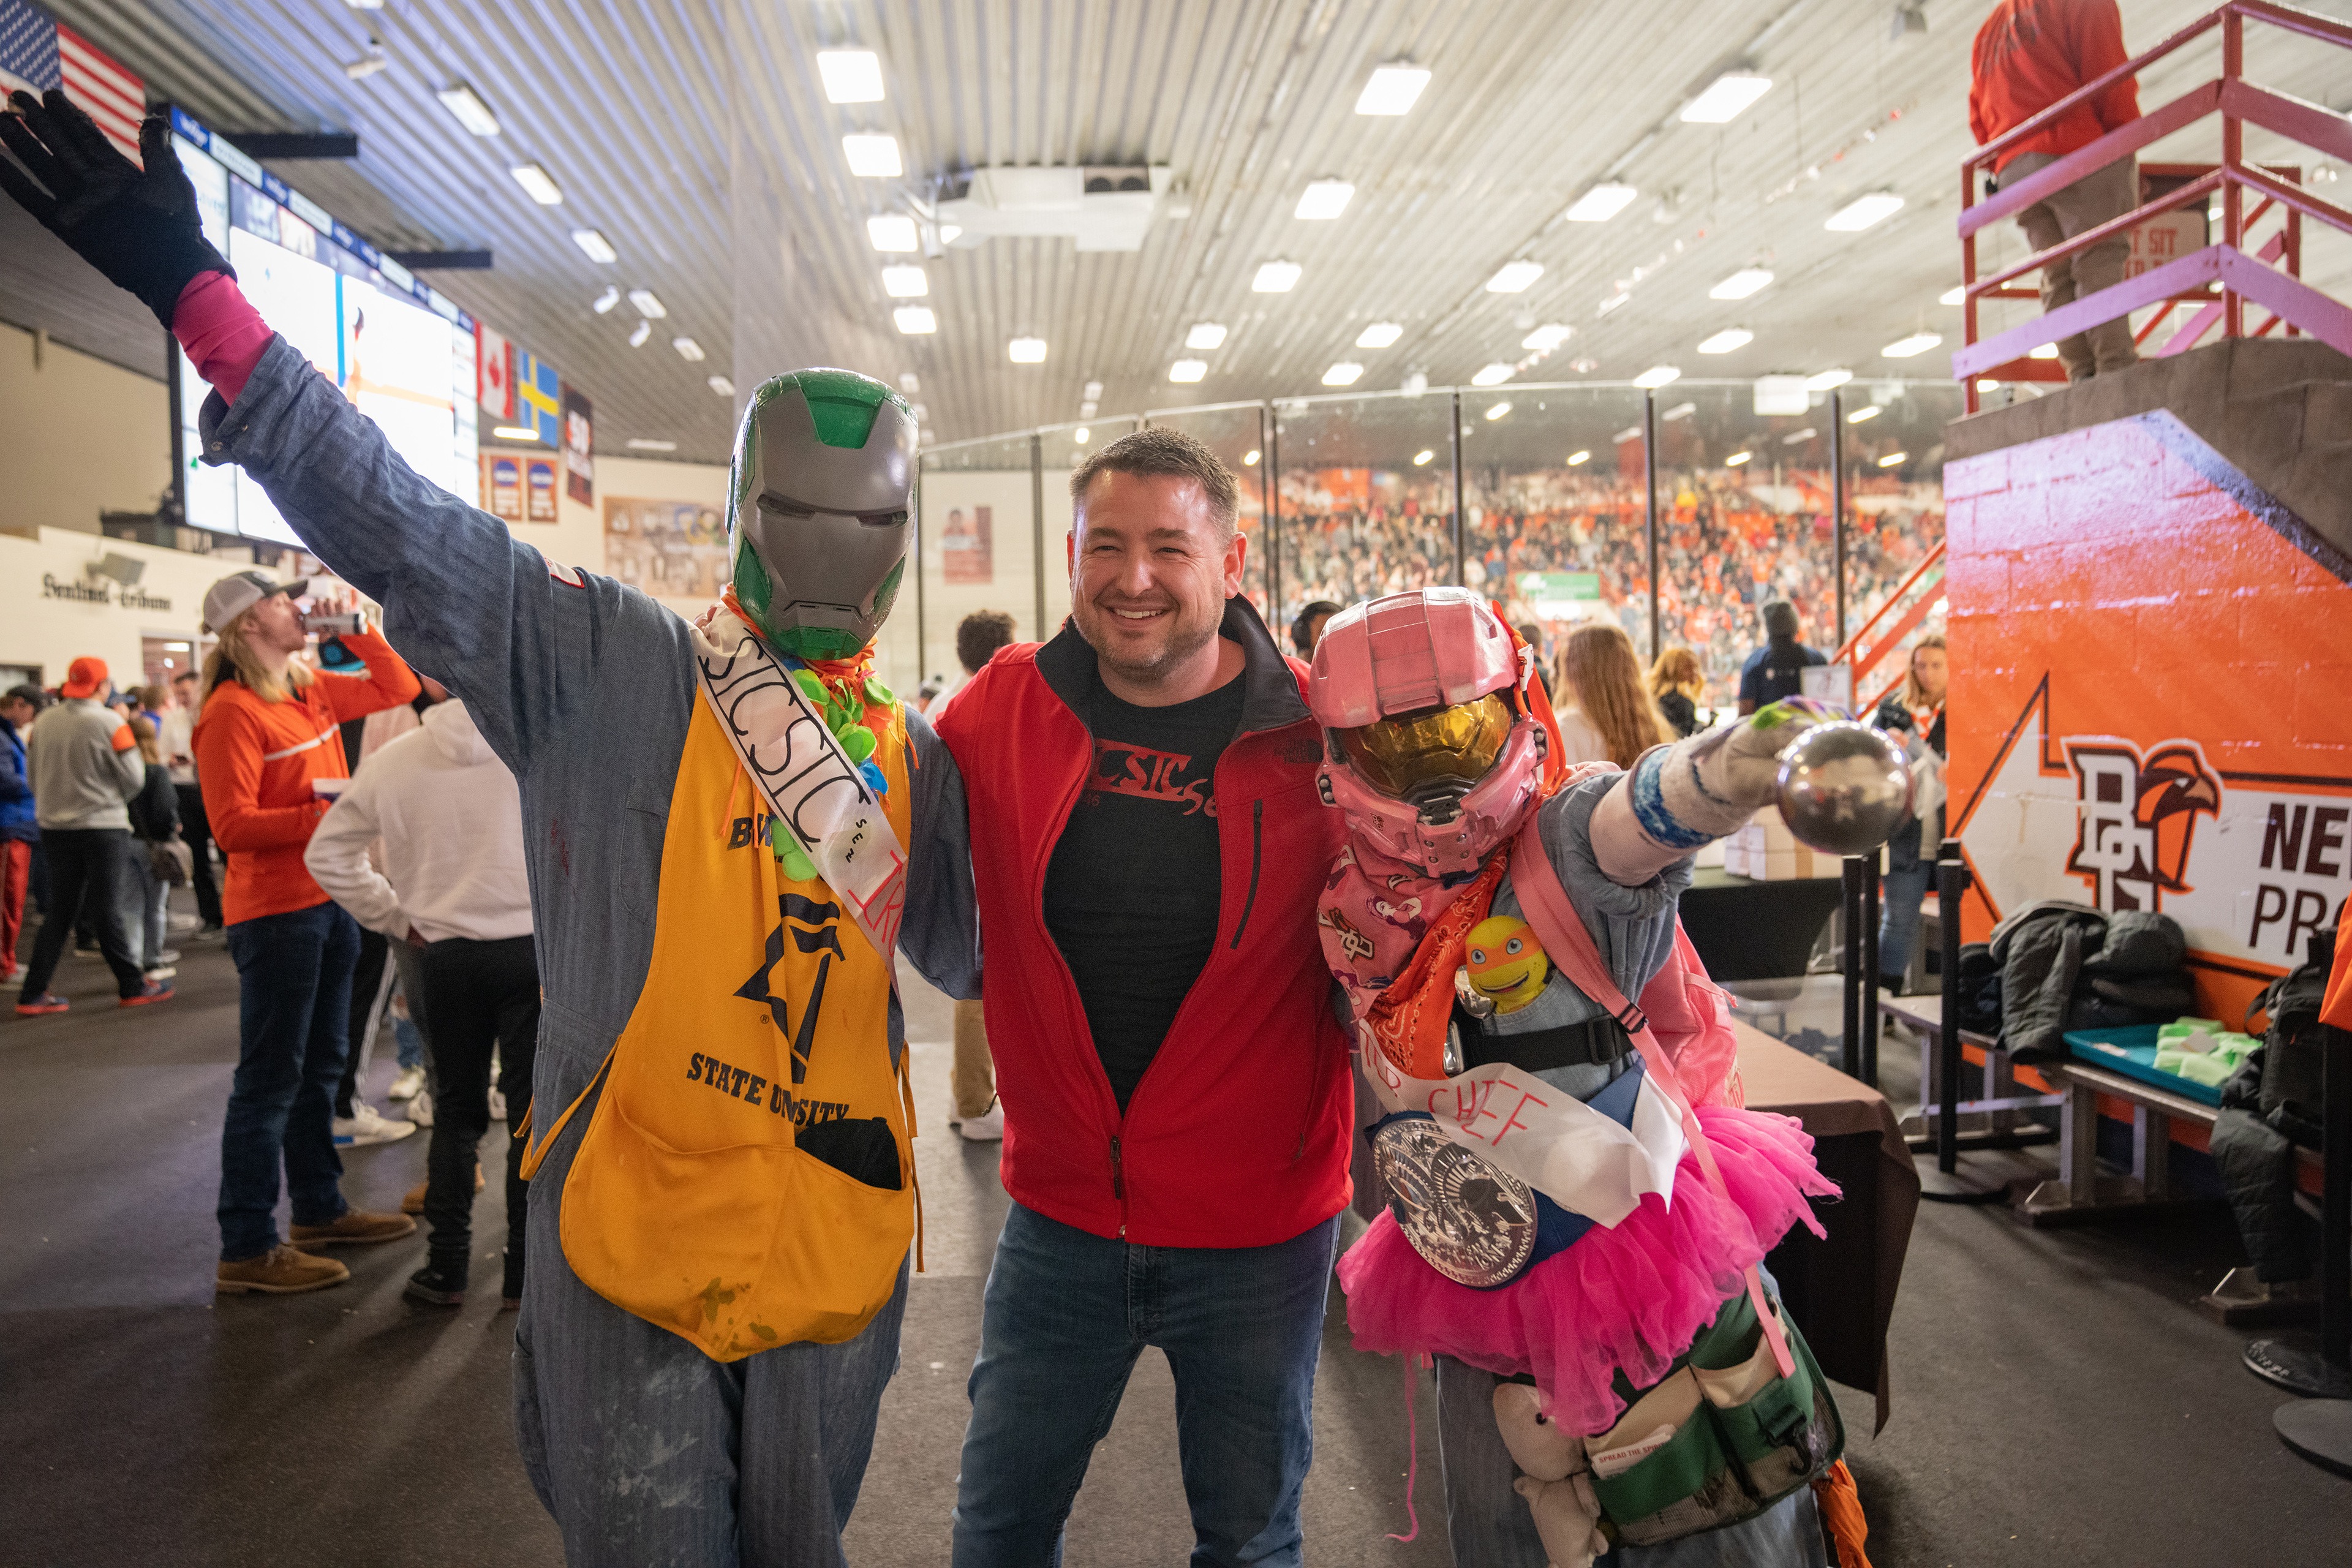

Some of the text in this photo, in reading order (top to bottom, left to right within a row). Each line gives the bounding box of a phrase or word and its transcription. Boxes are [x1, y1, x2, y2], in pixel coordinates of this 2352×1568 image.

[2148, 227, 2177, 255] SIT
[2260, 802, 2352, 880] NE
[687, 1052, 767, 1106] STATE
[1599, 1451, 1626, 1463] SPREAD
[1628, 1448, 1641, 1457] THE
